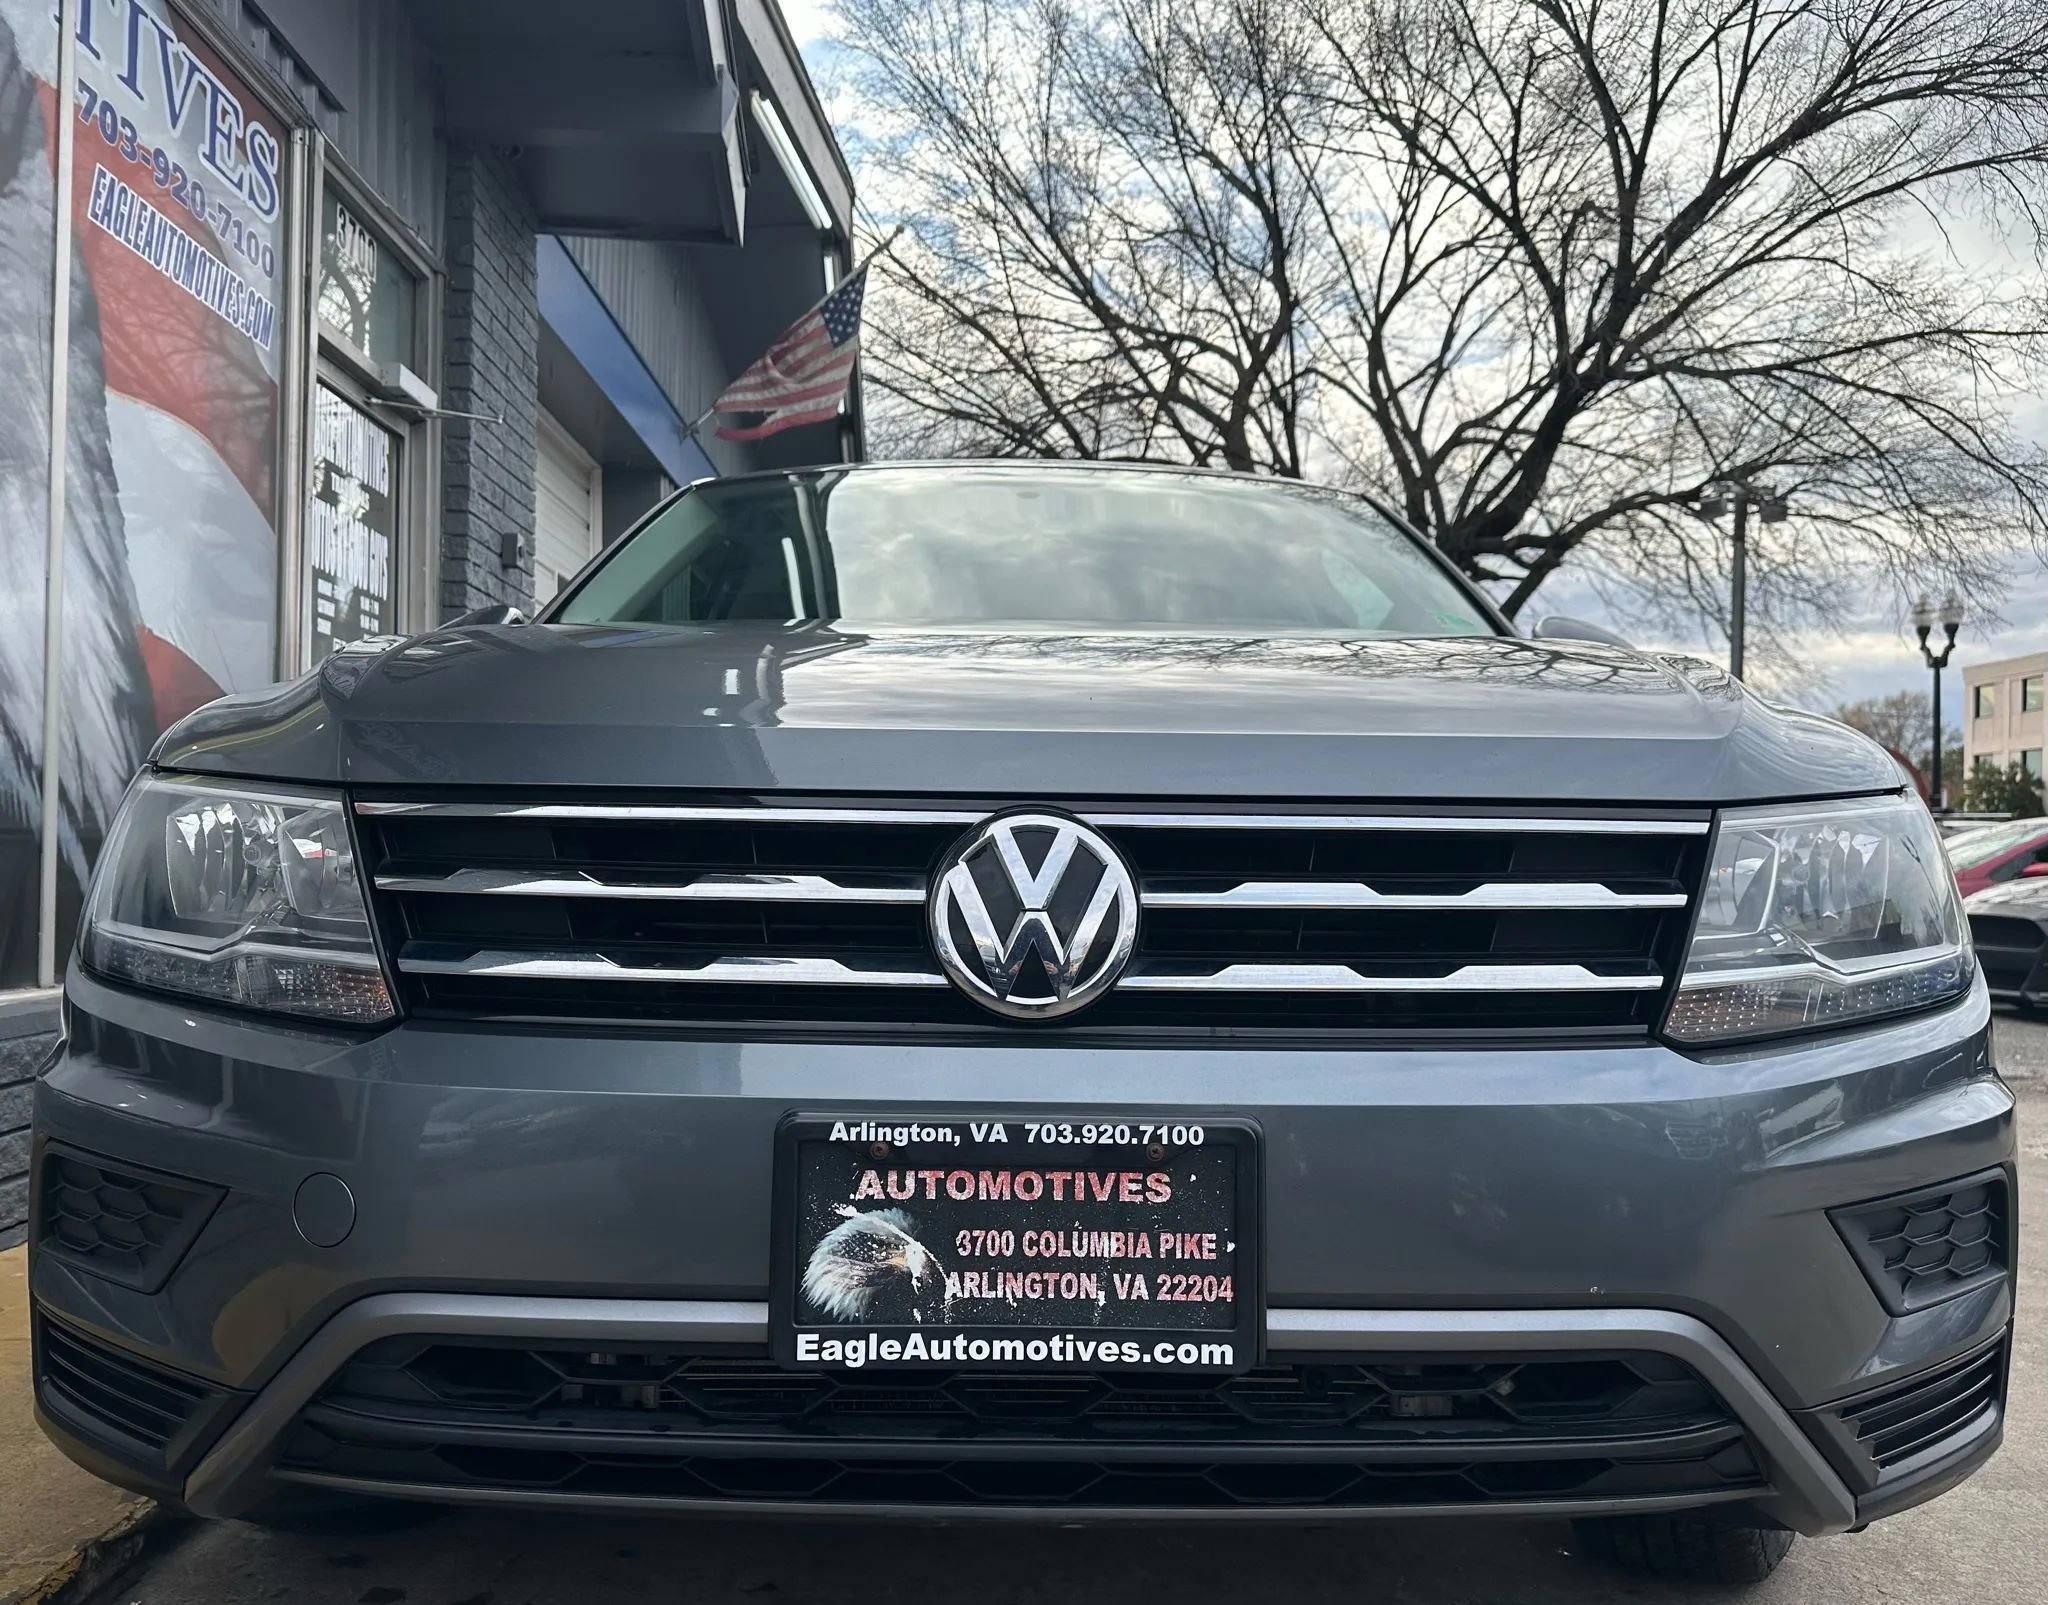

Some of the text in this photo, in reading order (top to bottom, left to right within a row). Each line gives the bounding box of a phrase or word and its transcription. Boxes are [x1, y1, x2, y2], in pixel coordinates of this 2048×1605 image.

[78, 77, 275, 280] 703-920-7100
[89, 165, 275, 349] EAGLEAUTOMOTIVES.COM
[338, 205, 376, 279] 3700
[942, 822, 1126, 1004] VW
[829, 1121, 1205, 1147] Arlington, VA 703.920.7100
[855, 1168, 1172, 1204] AUTOMOTIVES
[956, 1229, 1217, 1260] 3700 COLUMBIA PIKE
[945, 1271, 1235, 1303] ARLINGTON, VA 22204
[796, 1332, 1235, 1368] EagleAutomotives.com
